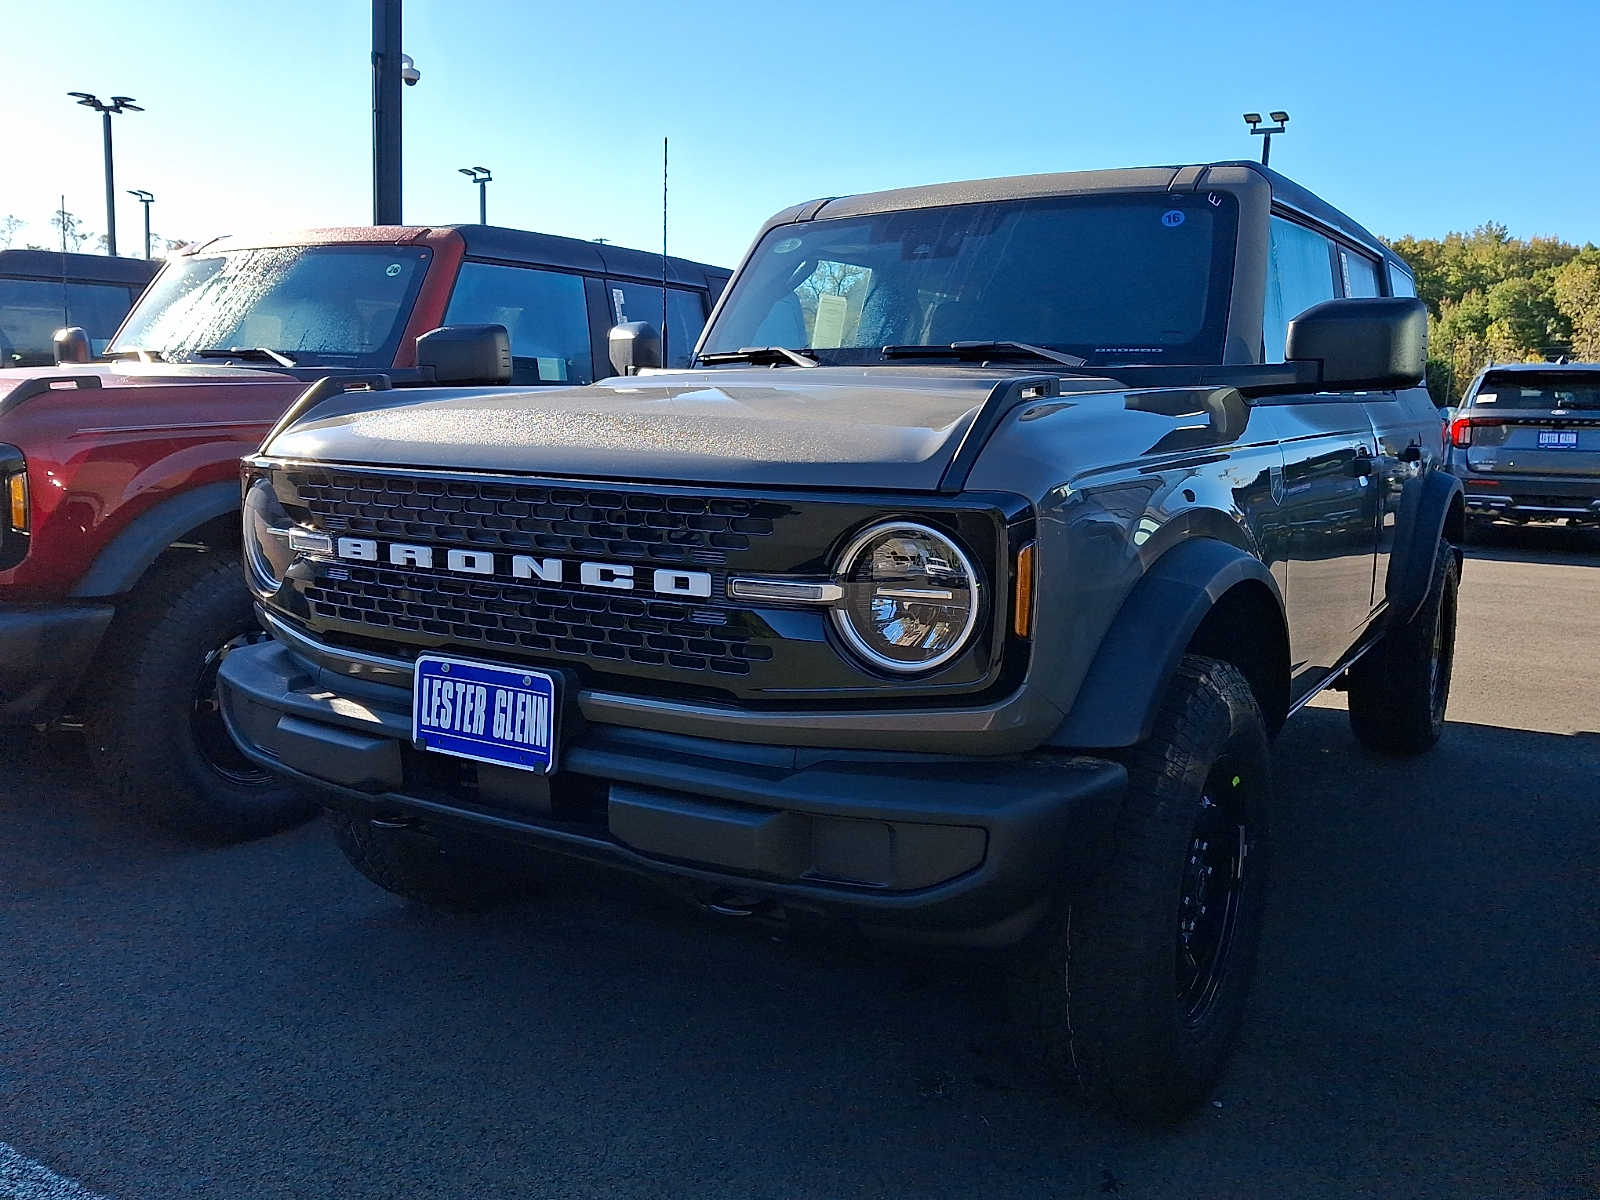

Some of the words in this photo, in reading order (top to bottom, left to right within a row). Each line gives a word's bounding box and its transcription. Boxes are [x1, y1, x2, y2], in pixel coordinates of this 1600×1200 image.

[338, 537, 712, 598] BRONCO
[421, 678, 487, 736] LESTER
[492, 689, 549, 748] GLENN
